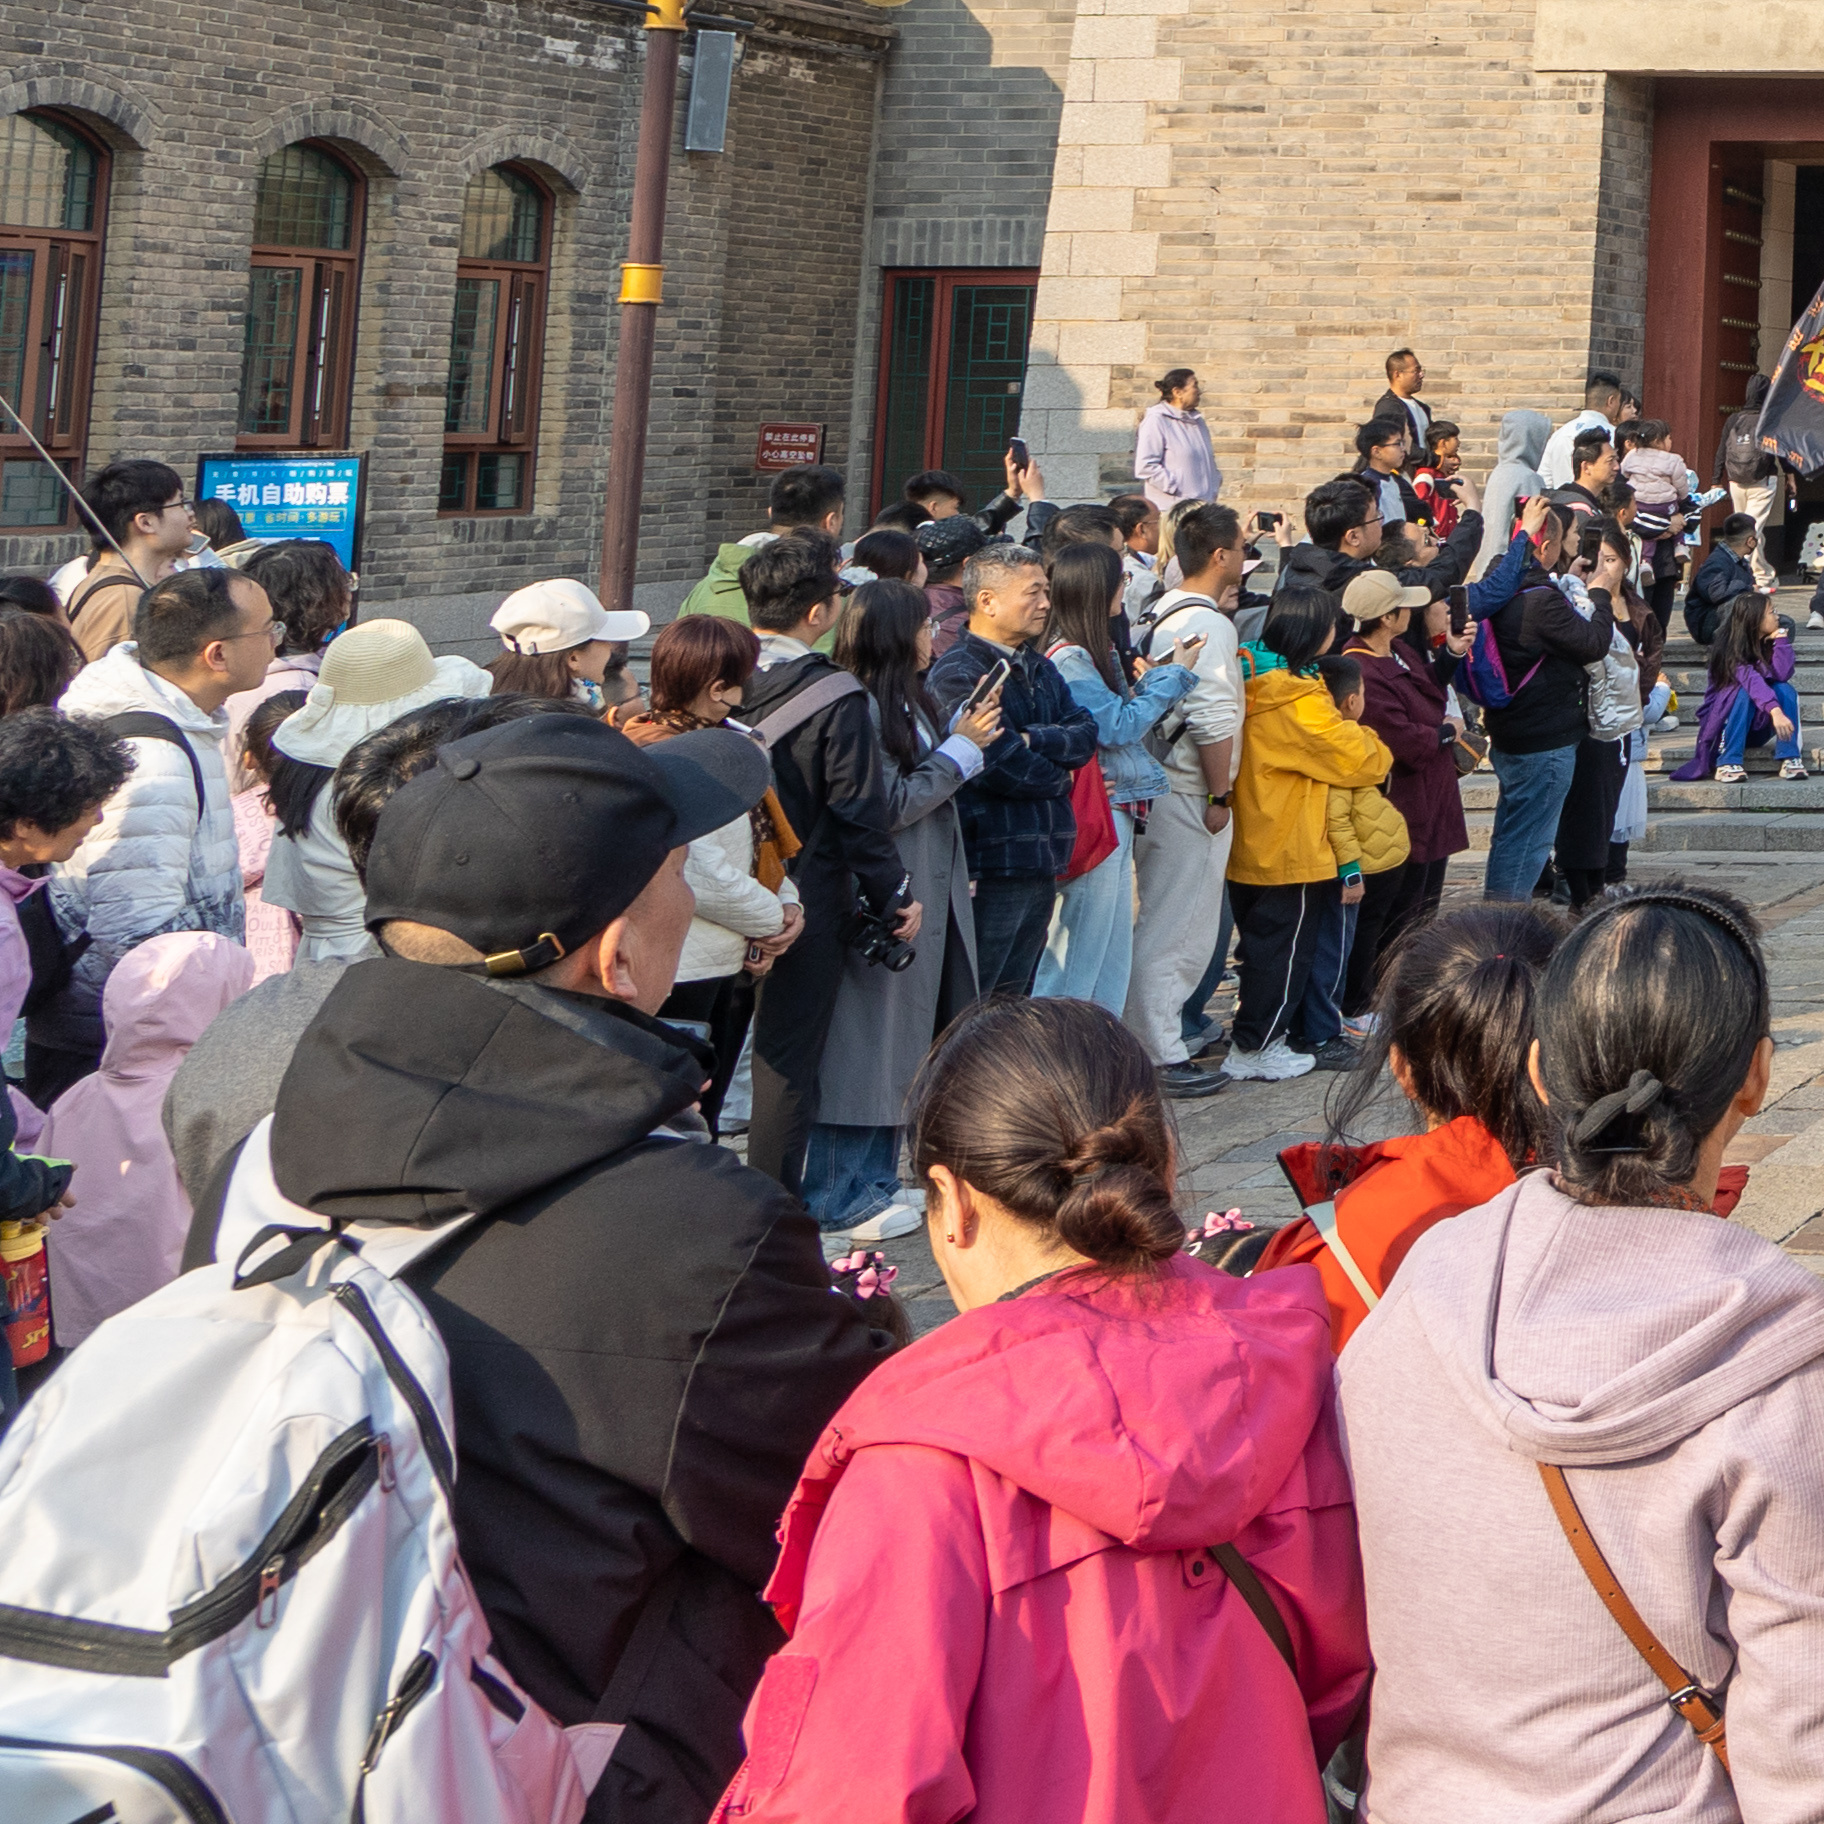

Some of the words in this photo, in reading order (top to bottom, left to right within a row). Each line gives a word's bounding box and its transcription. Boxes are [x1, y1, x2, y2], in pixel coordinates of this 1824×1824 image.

[214, 482, 349, 506] 手机自助购票
